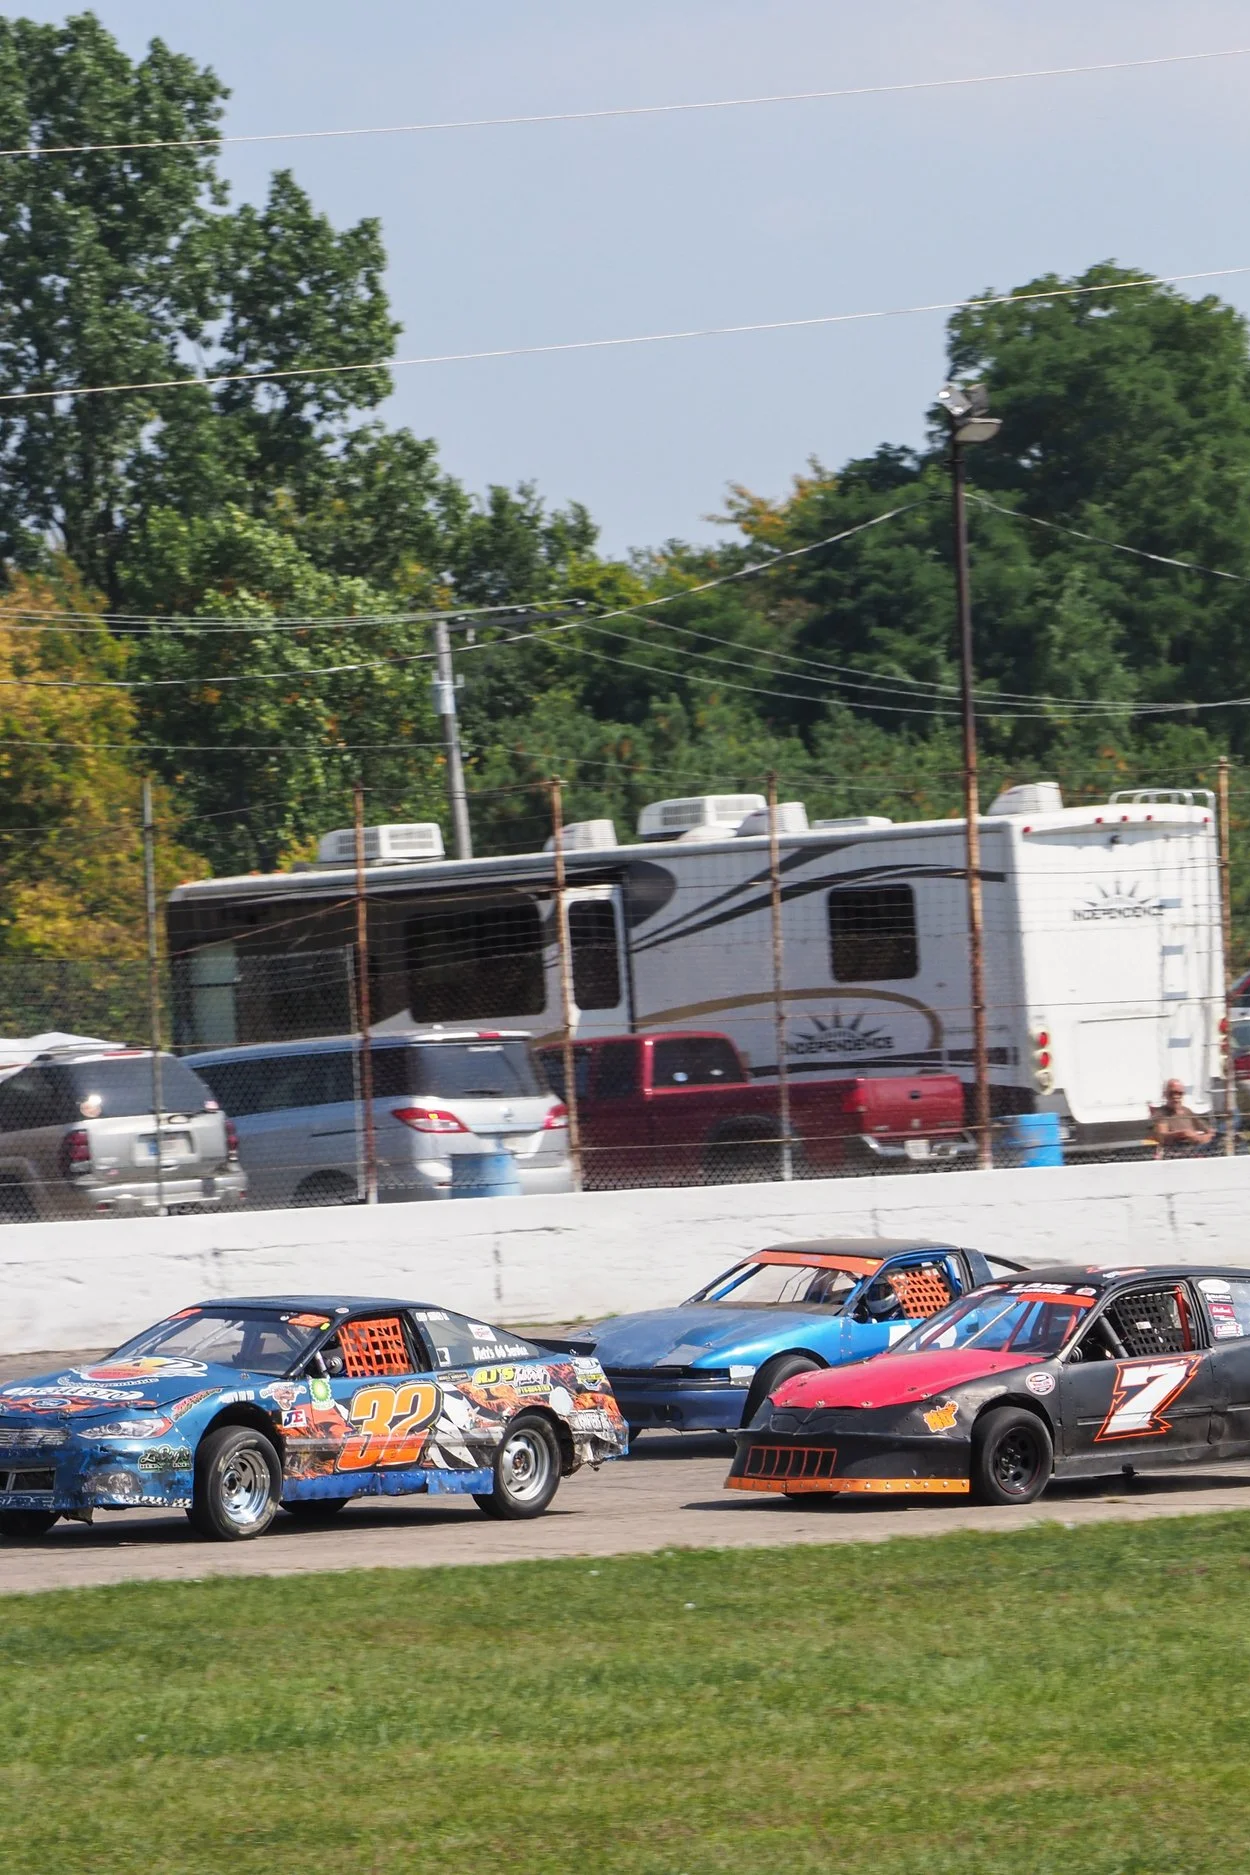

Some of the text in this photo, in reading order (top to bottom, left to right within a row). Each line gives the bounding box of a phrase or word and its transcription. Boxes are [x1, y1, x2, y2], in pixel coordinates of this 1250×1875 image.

[474, 1366, 516, 1384] AJ'S
[1099, 1358, 1195, 1437] 7
[335, 1380, 442, 1472] 32
